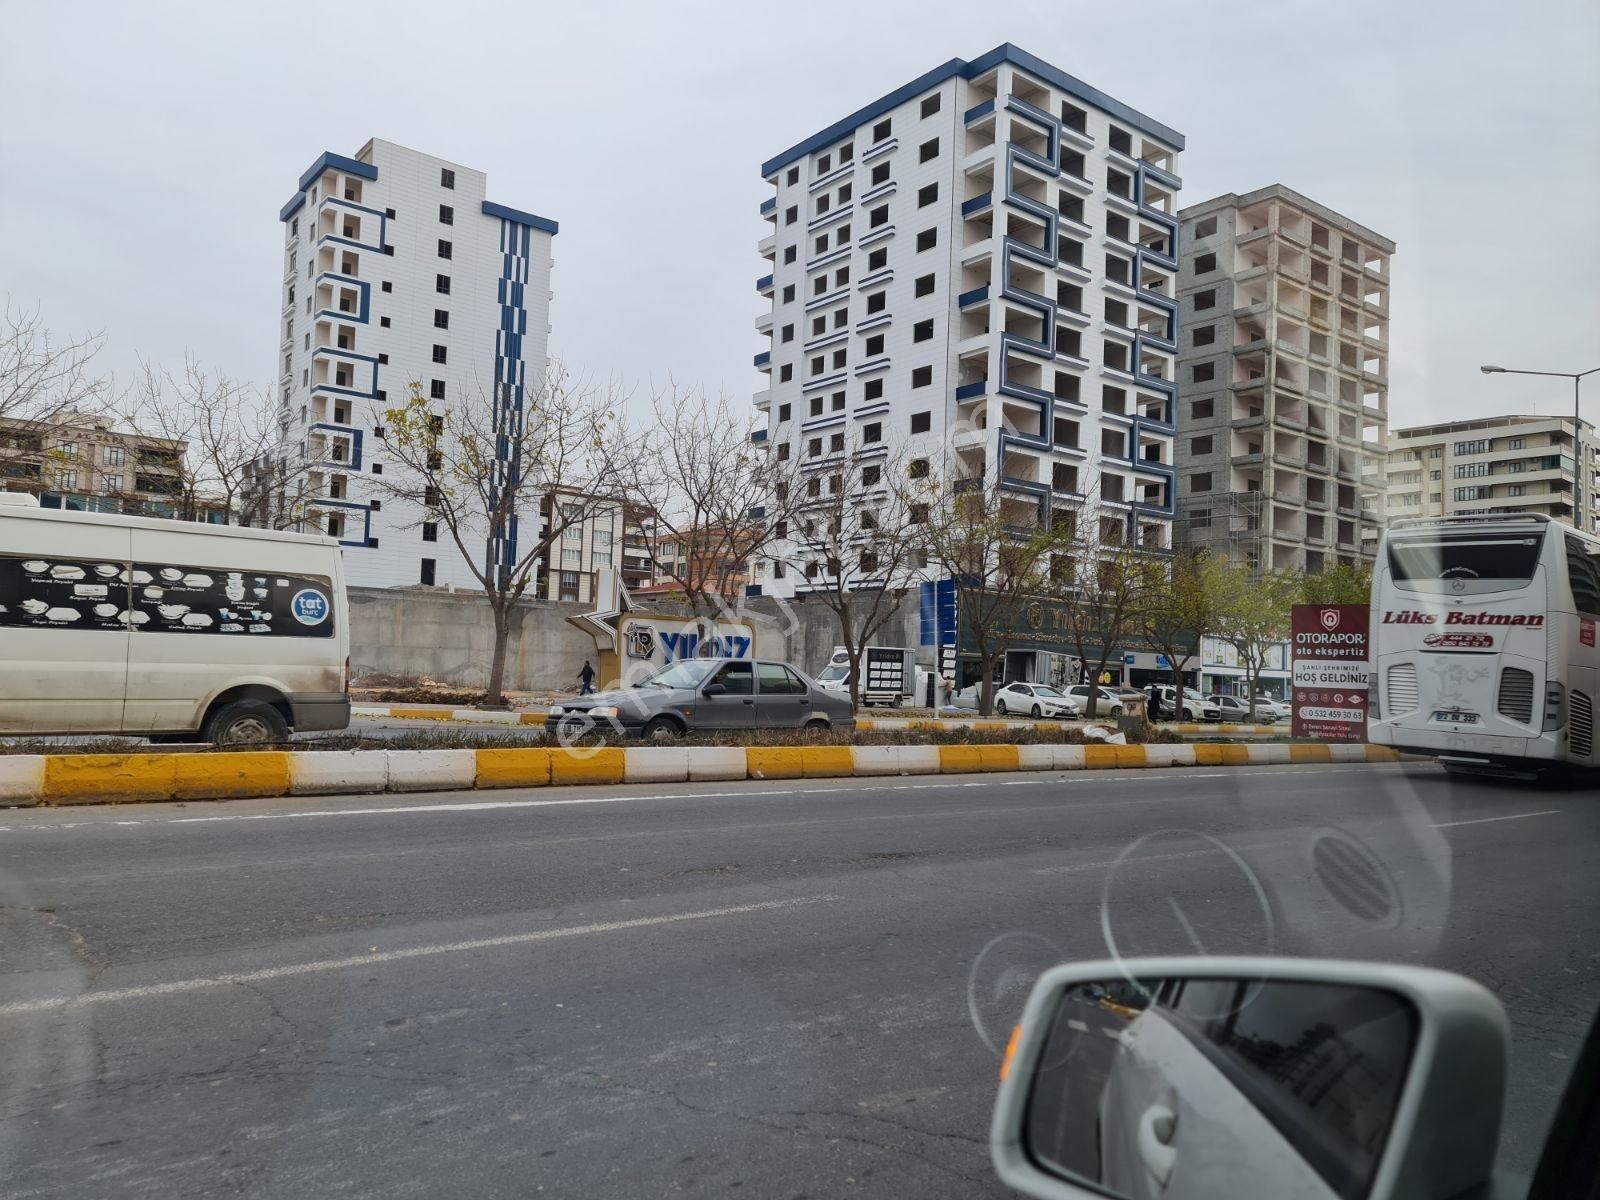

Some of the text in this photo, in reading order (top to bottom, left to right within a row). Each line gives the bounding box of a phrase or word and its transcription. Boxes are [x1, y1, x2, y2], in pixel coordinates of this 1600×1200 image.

[299, 597, 322, 610] tat
[1382, 610, 1545, 626] Lüks Batman
[1296, 632, 1366, 644] OTORAPOR
[1296, 647, 1365, 657] oto ekspertiz
[1295, 672, 1368, 685] HOŞ GELDİNİZ
[1308, 709, 1314, 717] 0
[1328, 710, 1342, 718] 459
[1353, 712, 1362, 720] 63
